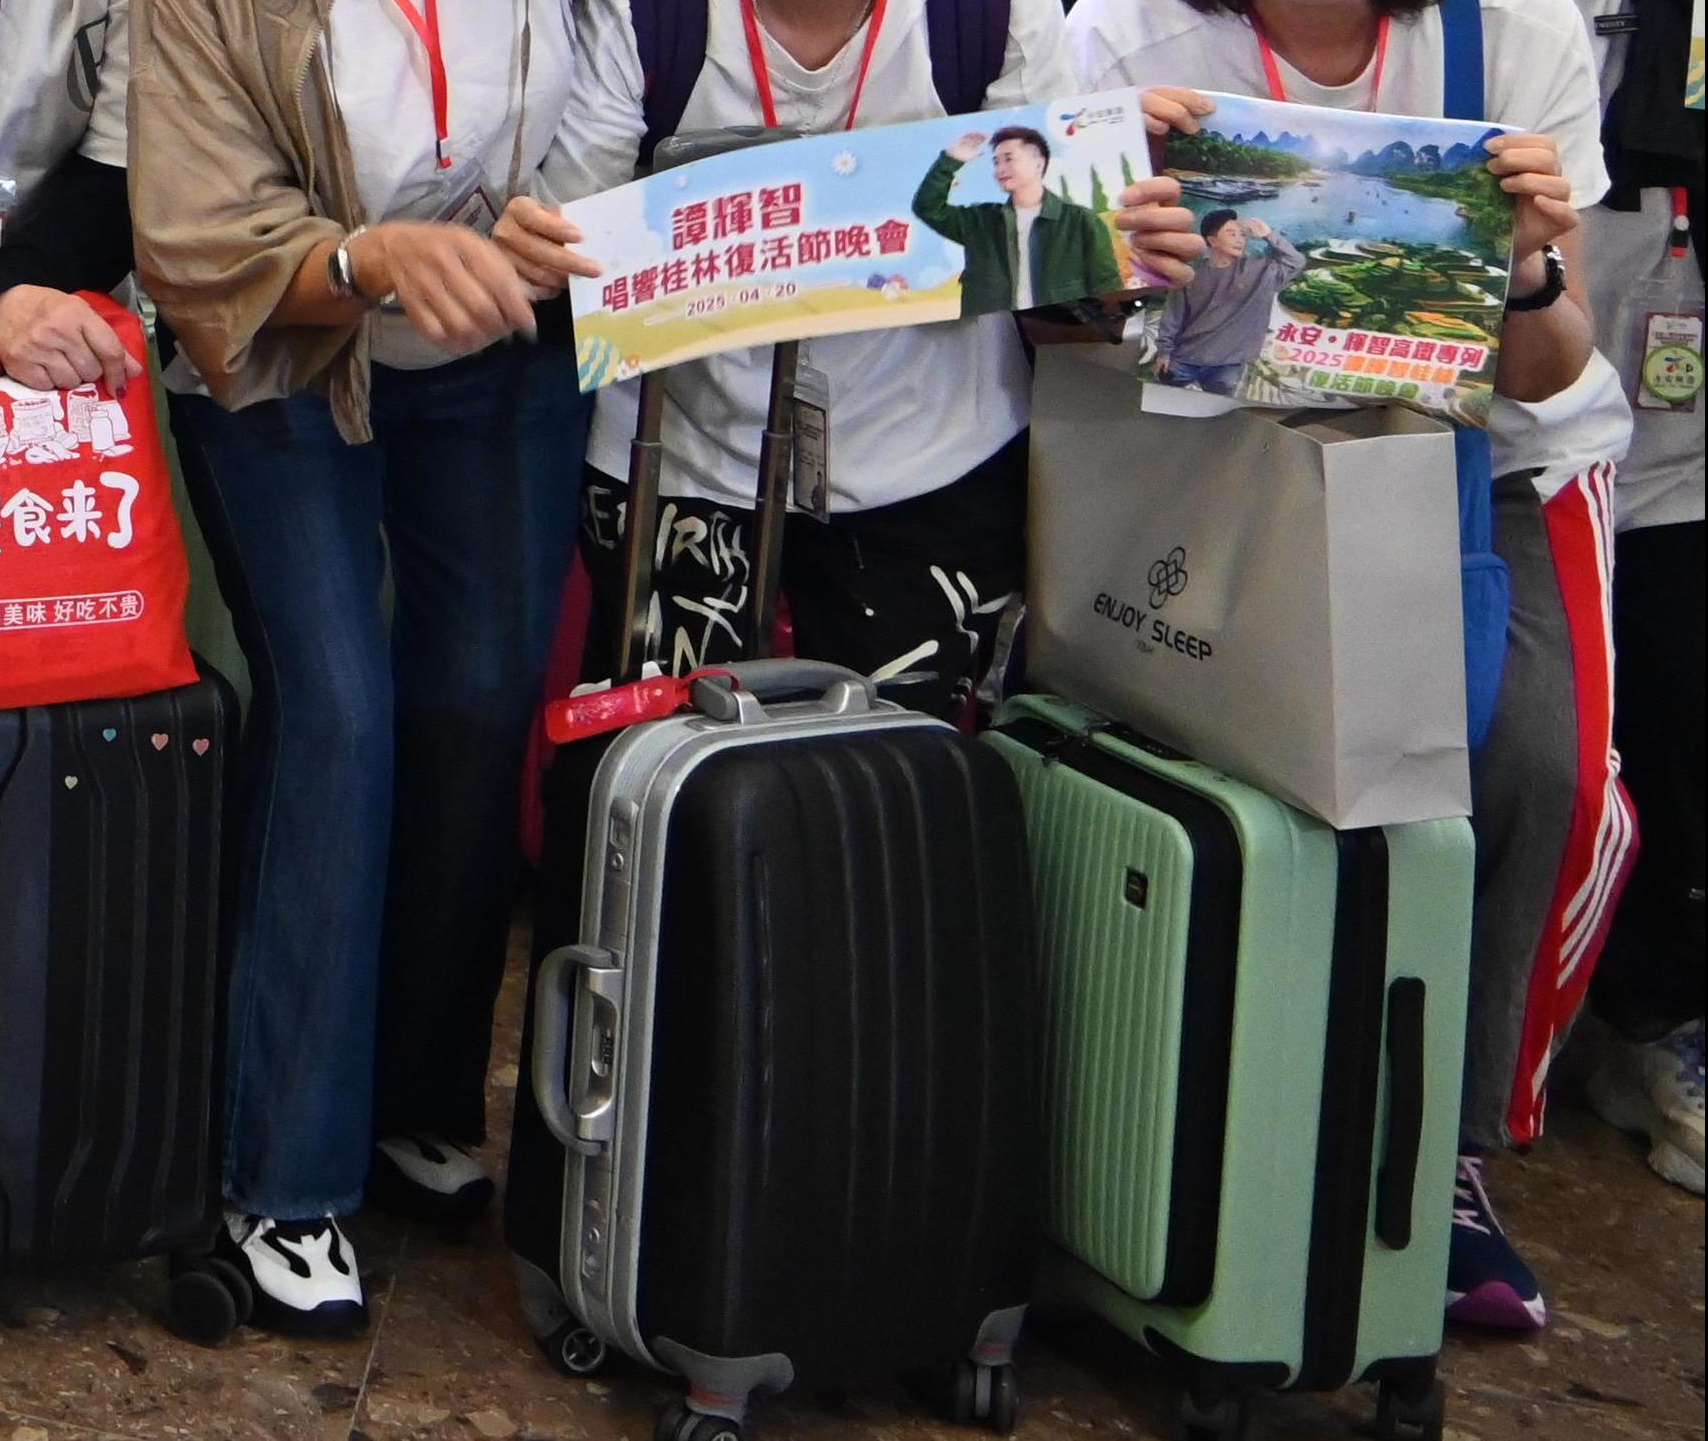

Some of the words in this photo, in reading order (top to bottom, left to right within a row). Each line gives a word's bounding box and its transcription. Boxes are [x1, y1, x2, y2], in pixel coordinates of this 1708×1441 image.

[670, 182, 803, 252] 譚輝智
[601, 217, 912, 313] 唱響桂林復活節晚會
[686, 296, 726, 317] 2025
[53, 594, 139, 622] 好吃不贵
[1093, 592, 1147, 632] ENJOY
[1151, 619, 1213, 661] SLEEP
